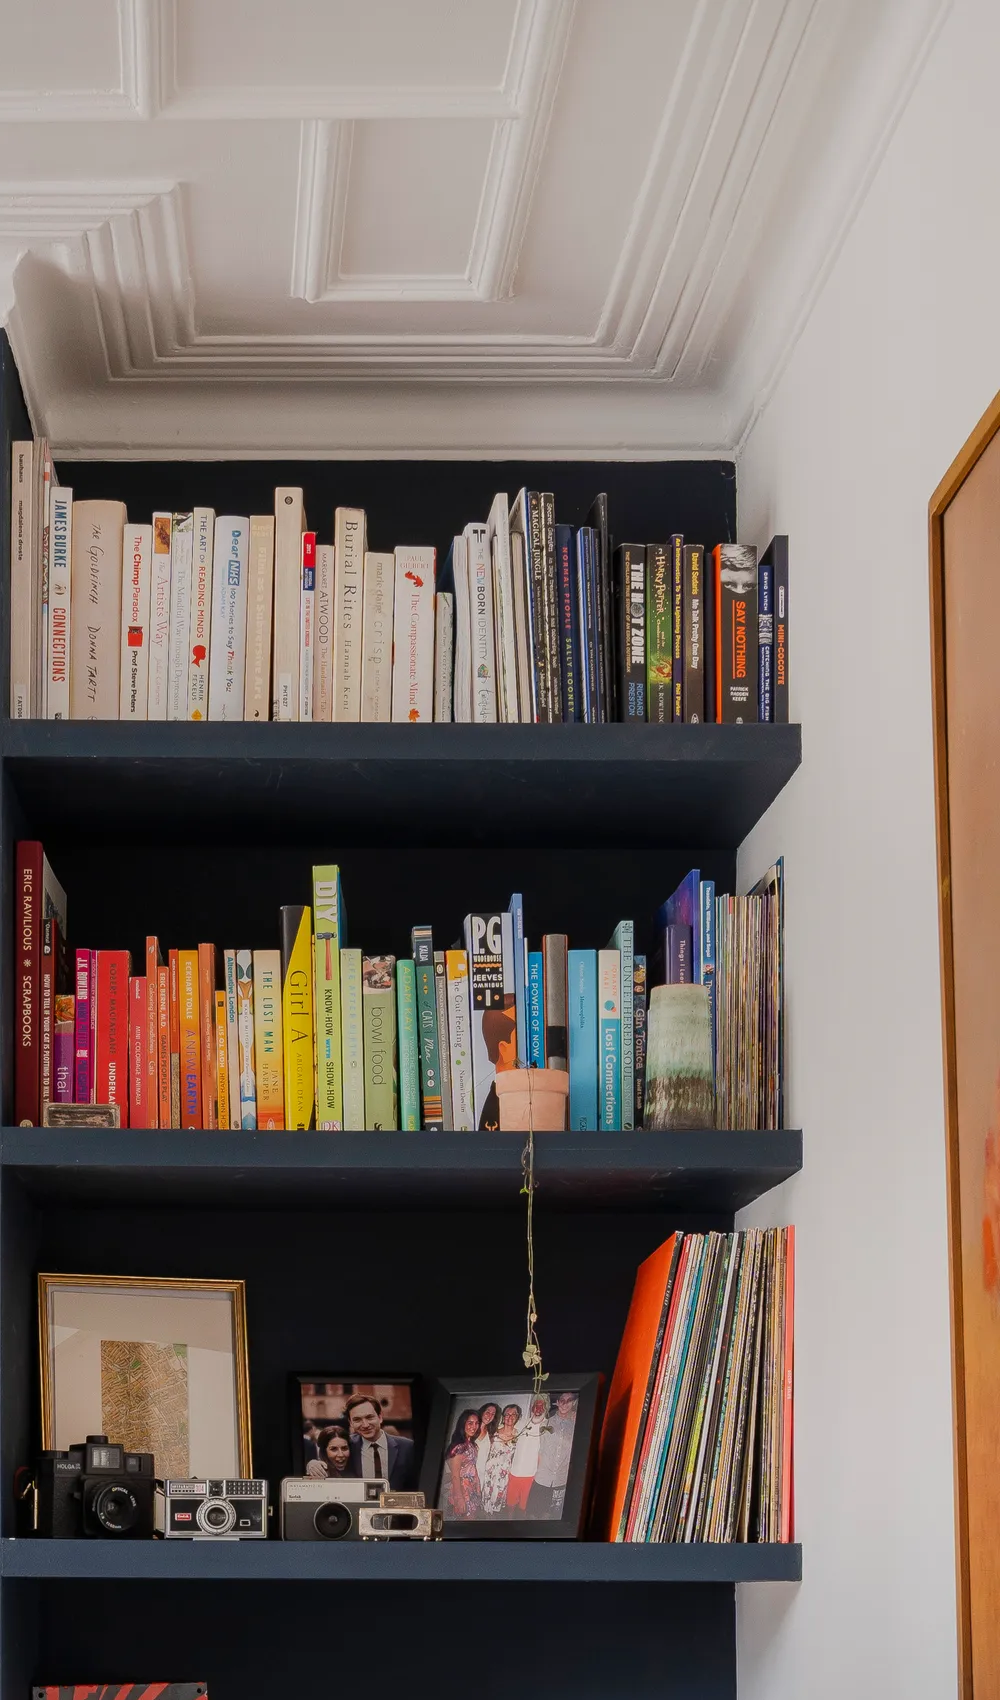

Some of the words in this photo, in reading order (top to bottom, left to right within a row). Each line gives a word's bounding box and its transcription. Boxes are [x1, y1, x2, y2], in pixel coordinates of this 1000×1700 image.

[54, 500, 66, 531] JAMES
[531, 510, 540, 546] MAGICAL
[54, 535, 66, 568] BURKE
[134, 536, 142, 552] The
[345, 521, 358, 574] Burial
[676, 538, 680, 546] An
[132, 554, 141, 585] Chimp
[533, 549, 542, 580] JUNGLE
[197, 566, 205, 606] READING
[132, 588, 140, 622] Paradox
[319, 591, 328, 643] ATWOOD
[343, 585, 355, 629] Rites
[692, 599, 699, 608] Me
[736, 601, 745, 624] SAY
[53, 608, 66, 682] CONNECTIONS
[87, 626, 100, 660] DONNA
[691, 624, 699, 642] Pretty
[691, 644, 699, 655] One
[736, 626, 746, 678] NOTHING
[87, 665, 97, 702] TARTT
[636, 683, 644, 715] RICHARD
[23, 869, 32, 892] ERIC
[316, 881, 337, 922] DIY
[23, 896, 32, 950] RAVILIOUS
[78, 958, 87, 970] J.K.
[623, 939, 631, 962] THE
[78, 972, 87, 999] ROWLING
[227, 957, 235, 994] Alternative
[263, 971, 272, 989] THE
[403, 966, 412, 1002] ADAM
[454, 974, 462, 992] The
[44, 989, 50, 997] TO
[289, 970, 308, 1015] Girl
[454, 995, 463, 1012] Gut
[623, 965, 632, 1046] UNTETHERED
[22, 976, 32, 1047] SCRAPBOOKS
[263, 997, 273, 1023] LOST
[371, 1007, 385, 1044] bowl
[404, 1008, 412, 1032] KAY
[636, 1009, 644, 1028] Gin
[291, 1029, 309, 1043] A
[454, 1015, 464, 1048] Feeling
[532, 1020, 539, 1032] OF
[606, 1028, 615, 1052] Lost
[264, 1032, 273, 1053] MAN
[635, 1031, 645, 1069] Tonica
[58, 1066, 68, 1093] thai
[372, 1049, 386, 1085] food
[624, 1050, 633, 1081] SOUL
[605, 1054, 616, 1124] Connections
